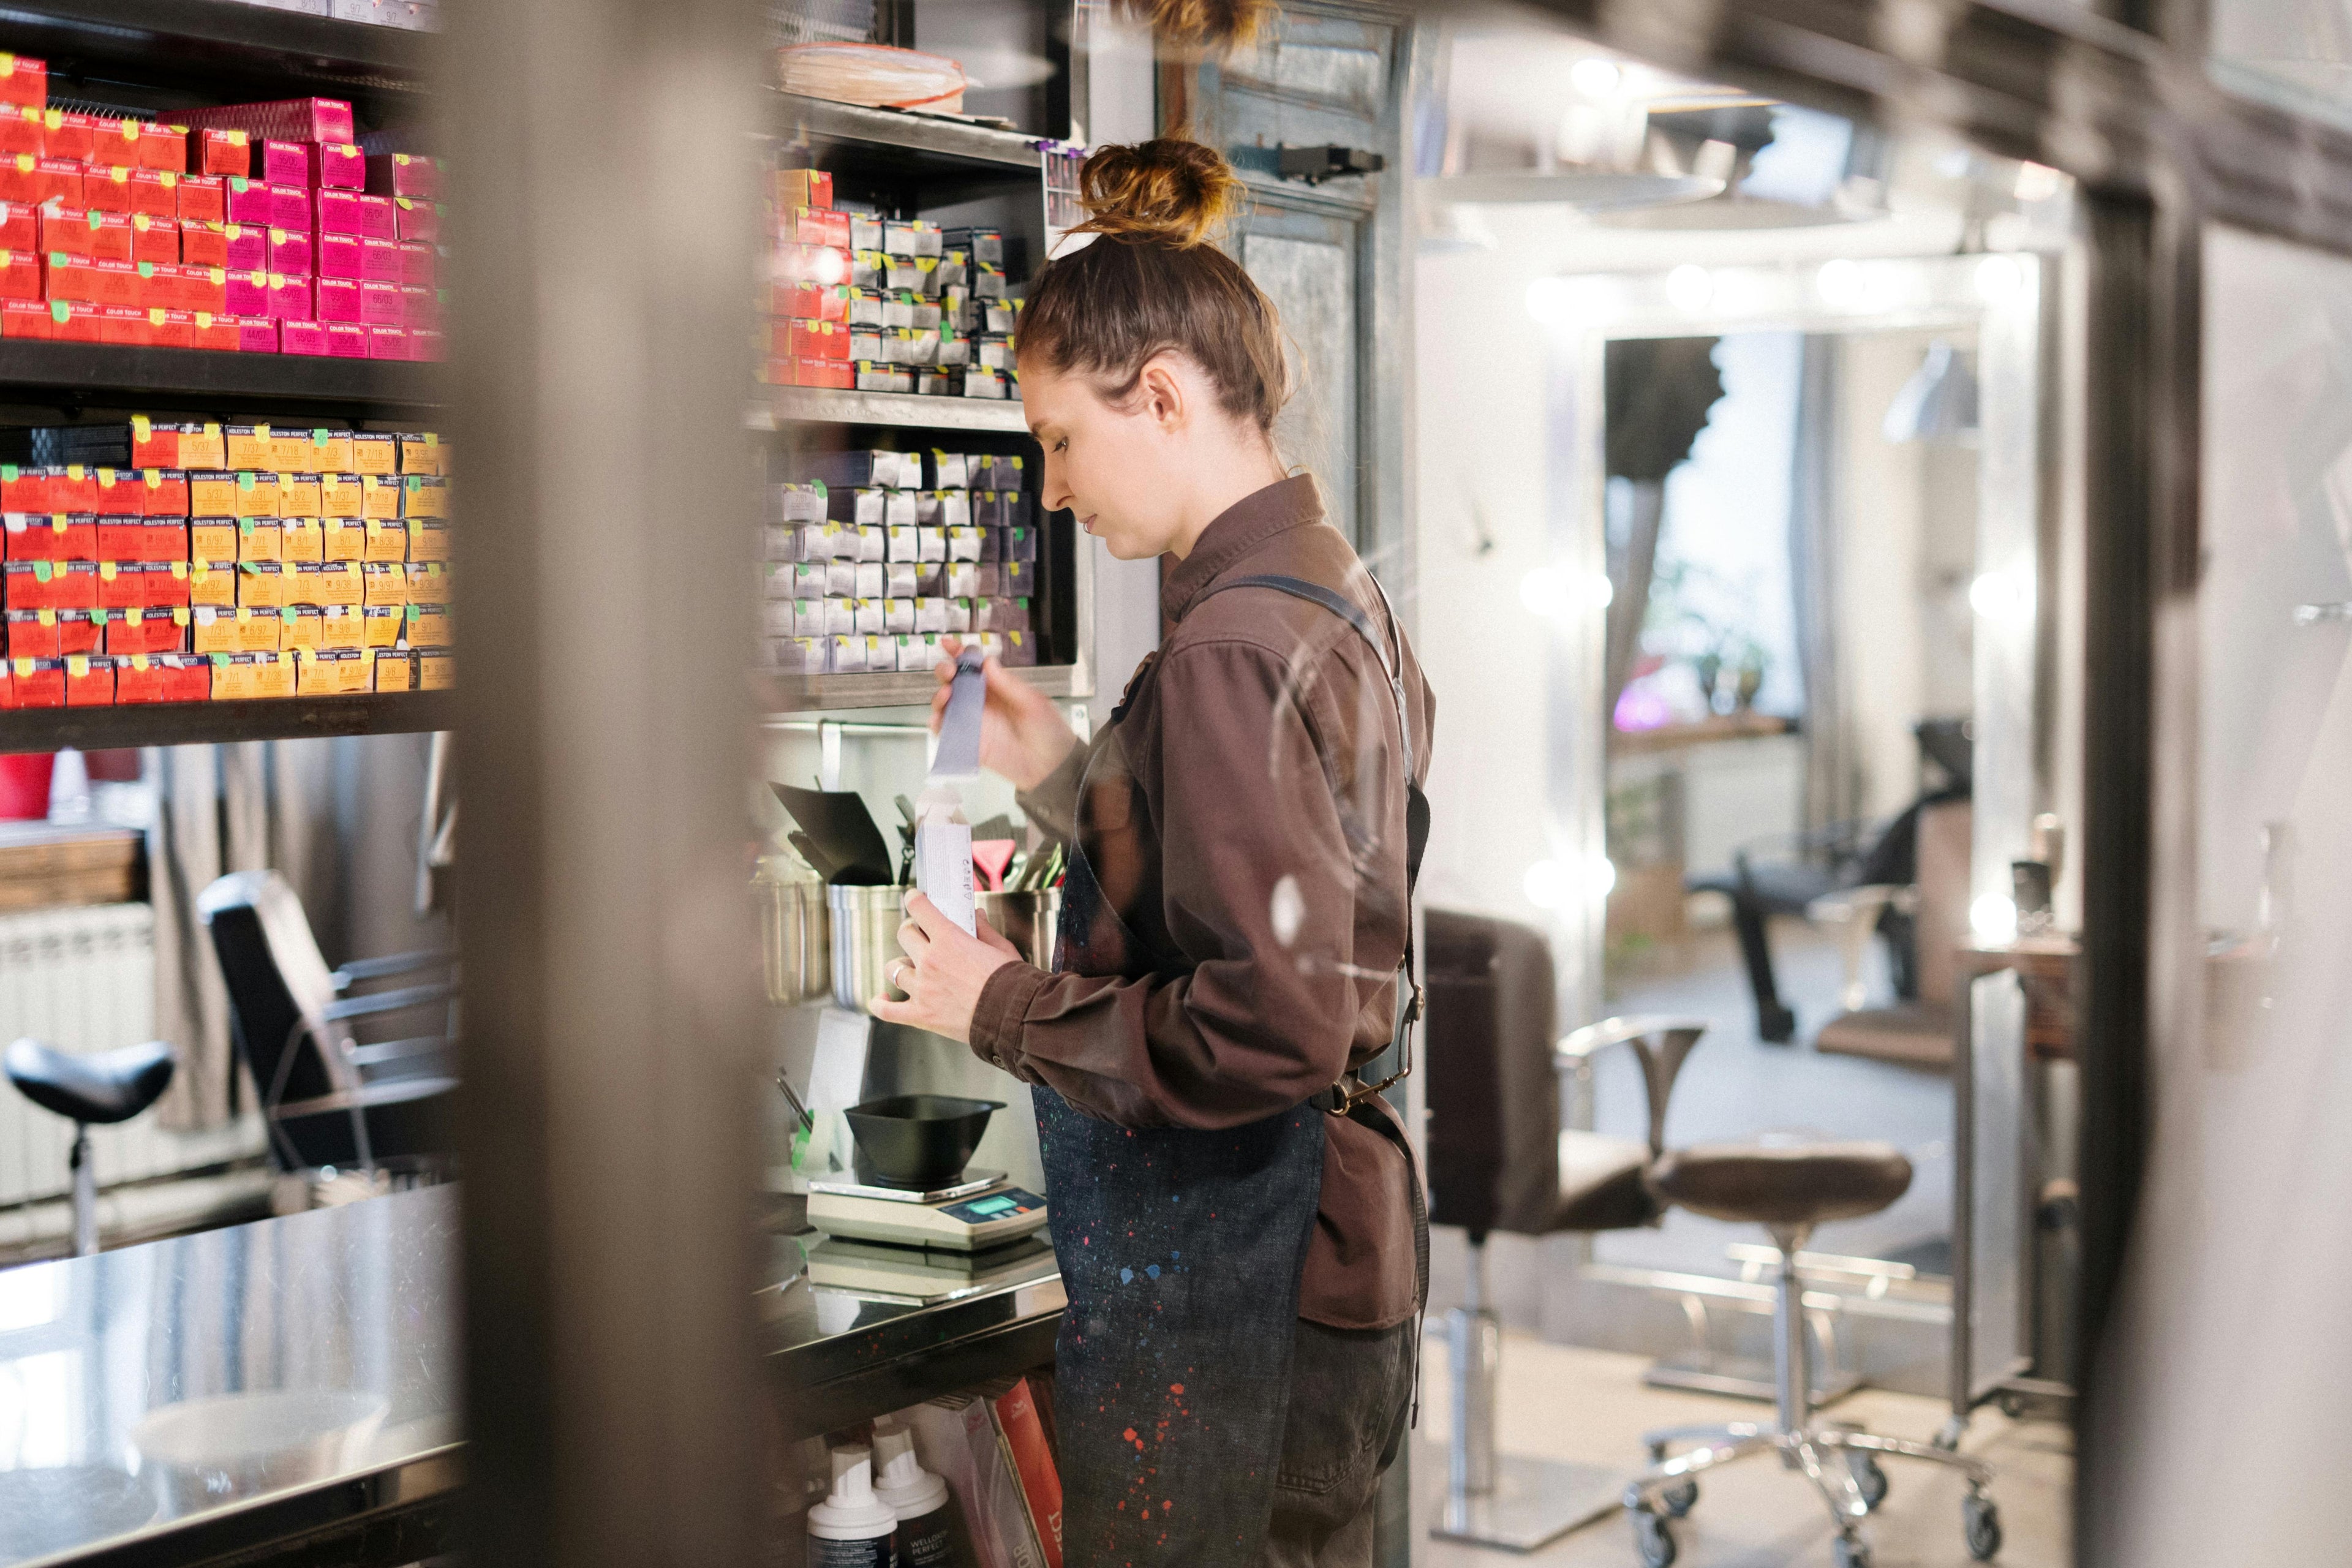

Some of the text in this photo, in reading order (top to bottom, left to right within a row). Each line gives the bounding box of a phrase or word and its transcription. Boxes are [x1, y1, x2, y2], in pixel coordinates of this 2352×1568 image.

[350, 3, 361, 13] 9/7
[386, 11, 397, 21] 9/7
[372, 250, 391, 261] 66/03
[373, 294, 393, 304] 66/03
[192, 442, 209, 451] 5/37
[243, 443, 259, 453] 7/37
[281, 446, 299, 455] 7/18
[326, 447, 338, 457] 7/3
[367, 449, 383, 459] 7/18
[252, 491, 266, 500] 7/31
[294, 491, 306, 500] 6/2
[375, 493, 389, 502] 7/18
[206, 535, 223, 545] 6/97
[255, 536, 265, 545] 7/1
[297, 535, 308, 545] 8/1
[340, 535, 351, 545] 8/1
[379, 537, 394, 546] 8/38
[257, 581, 266, 589] 7/1
[298, 580, 310, 589] 7/3
[336, 580, 351, 589] 9/38
[379, 581, 394, 590] 9/97
[210, 625, 225, 635] 7/31
[250, 625, 266, 635] 6/97
[297, 625, 307, 634] 7/1
[339, 624, 350, 633] 9/8
[314, 669, 324, 678] 7/1
[385, 666, 396, 676] 9/8
[228, 673, 238, 682] 7/1
[267, 671, 281, 681] 7/38
